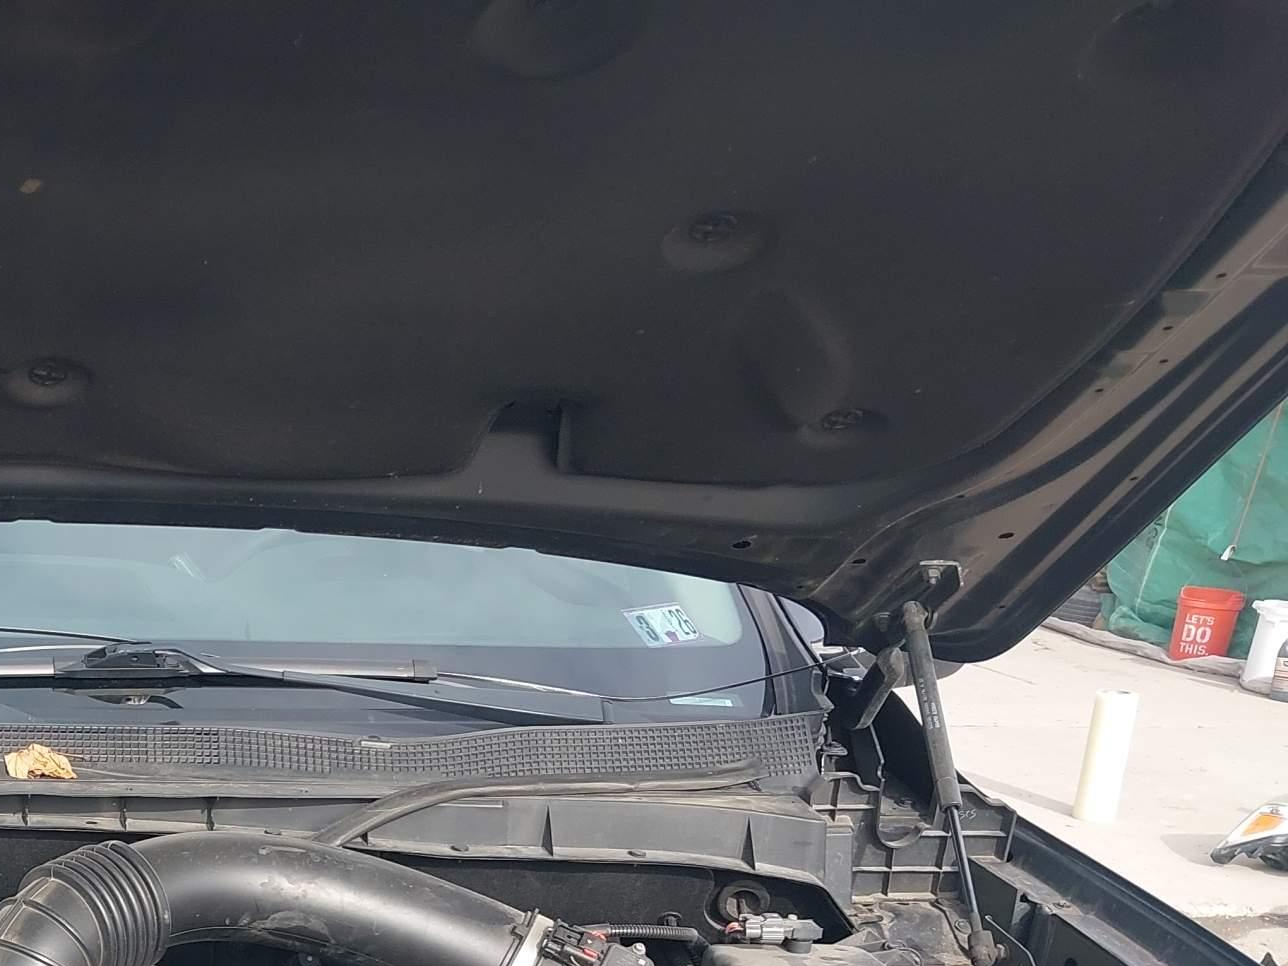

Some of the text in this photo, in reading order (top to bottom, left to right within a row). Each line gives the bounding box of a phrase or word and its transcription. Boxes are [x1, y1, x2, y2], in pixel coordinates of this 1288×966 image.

[636, 608, 698, 642] 3 26
[1185, 613, 1216, 626] LET'S
[1181, 623, 1212, 644] DO
[1179, 642, 1209, 656] THIS.
